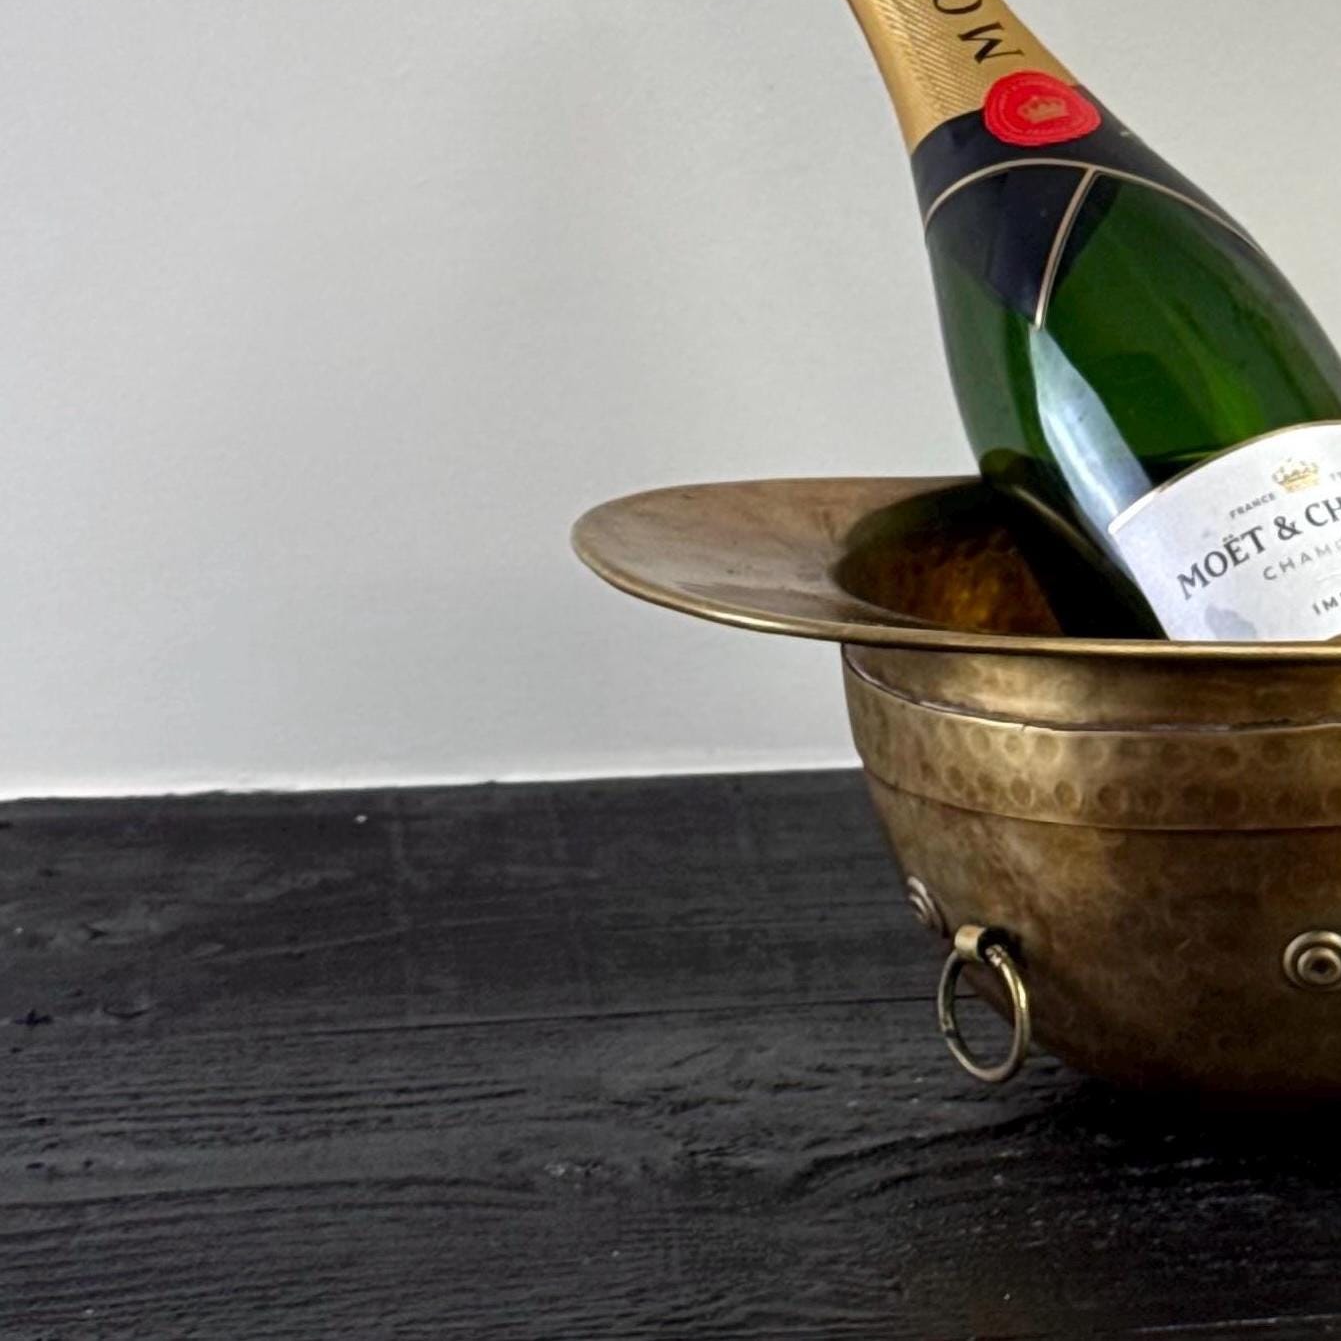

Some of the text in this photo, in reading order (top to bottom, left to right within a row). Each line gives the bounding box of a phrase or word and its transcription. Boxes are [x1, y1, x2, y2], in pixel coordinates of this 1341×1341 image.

[1229, 492, 1276, 519] FRANCE
[1177, 525, 1264, 600] MOËT
[1273, 515, 1304, 542] &
